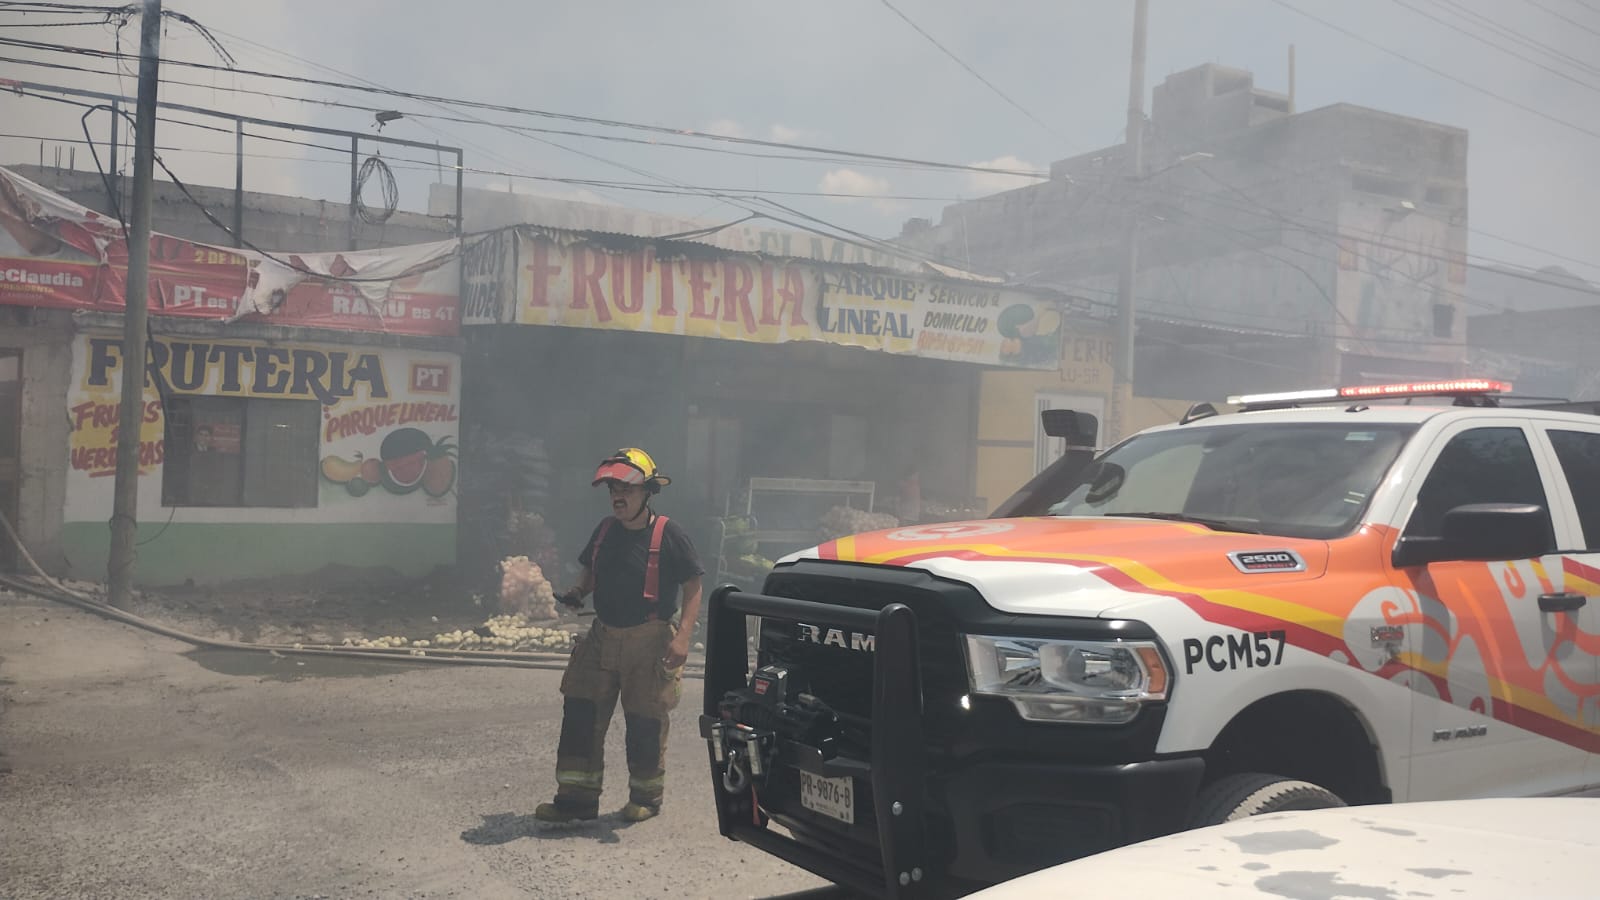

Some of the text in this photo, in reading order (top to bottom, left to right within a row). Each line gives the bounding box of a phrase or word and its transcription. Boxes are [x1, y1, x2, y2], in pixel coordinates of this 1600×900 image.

[194, 250, 204, 264] 2
[208, 251, 226, 264] DE
[174, 285, 207, 308] PT
[526, 242, 808, 334] FRUTERIA
[928, 284, 989, 308] SERVICIO
[435, 305, 455, 321] 4T
[817, 307, 914, 339] LINEAL
[924, 311, 989, 334] DOMICILIO
[88, 338, 389, 405] FRUTERIA
[415, 367, 444, 389] PT
[71, 400, 162, 431] FRUS
[399, 401, 457, 424] LINEAL
[1242, 553, 1290, 564] 2500
[797, 621, 876, 652] RAM
[1183, 629, 1286, 675] PCM57
[801, 773, 851, 809] PR-9876-B
